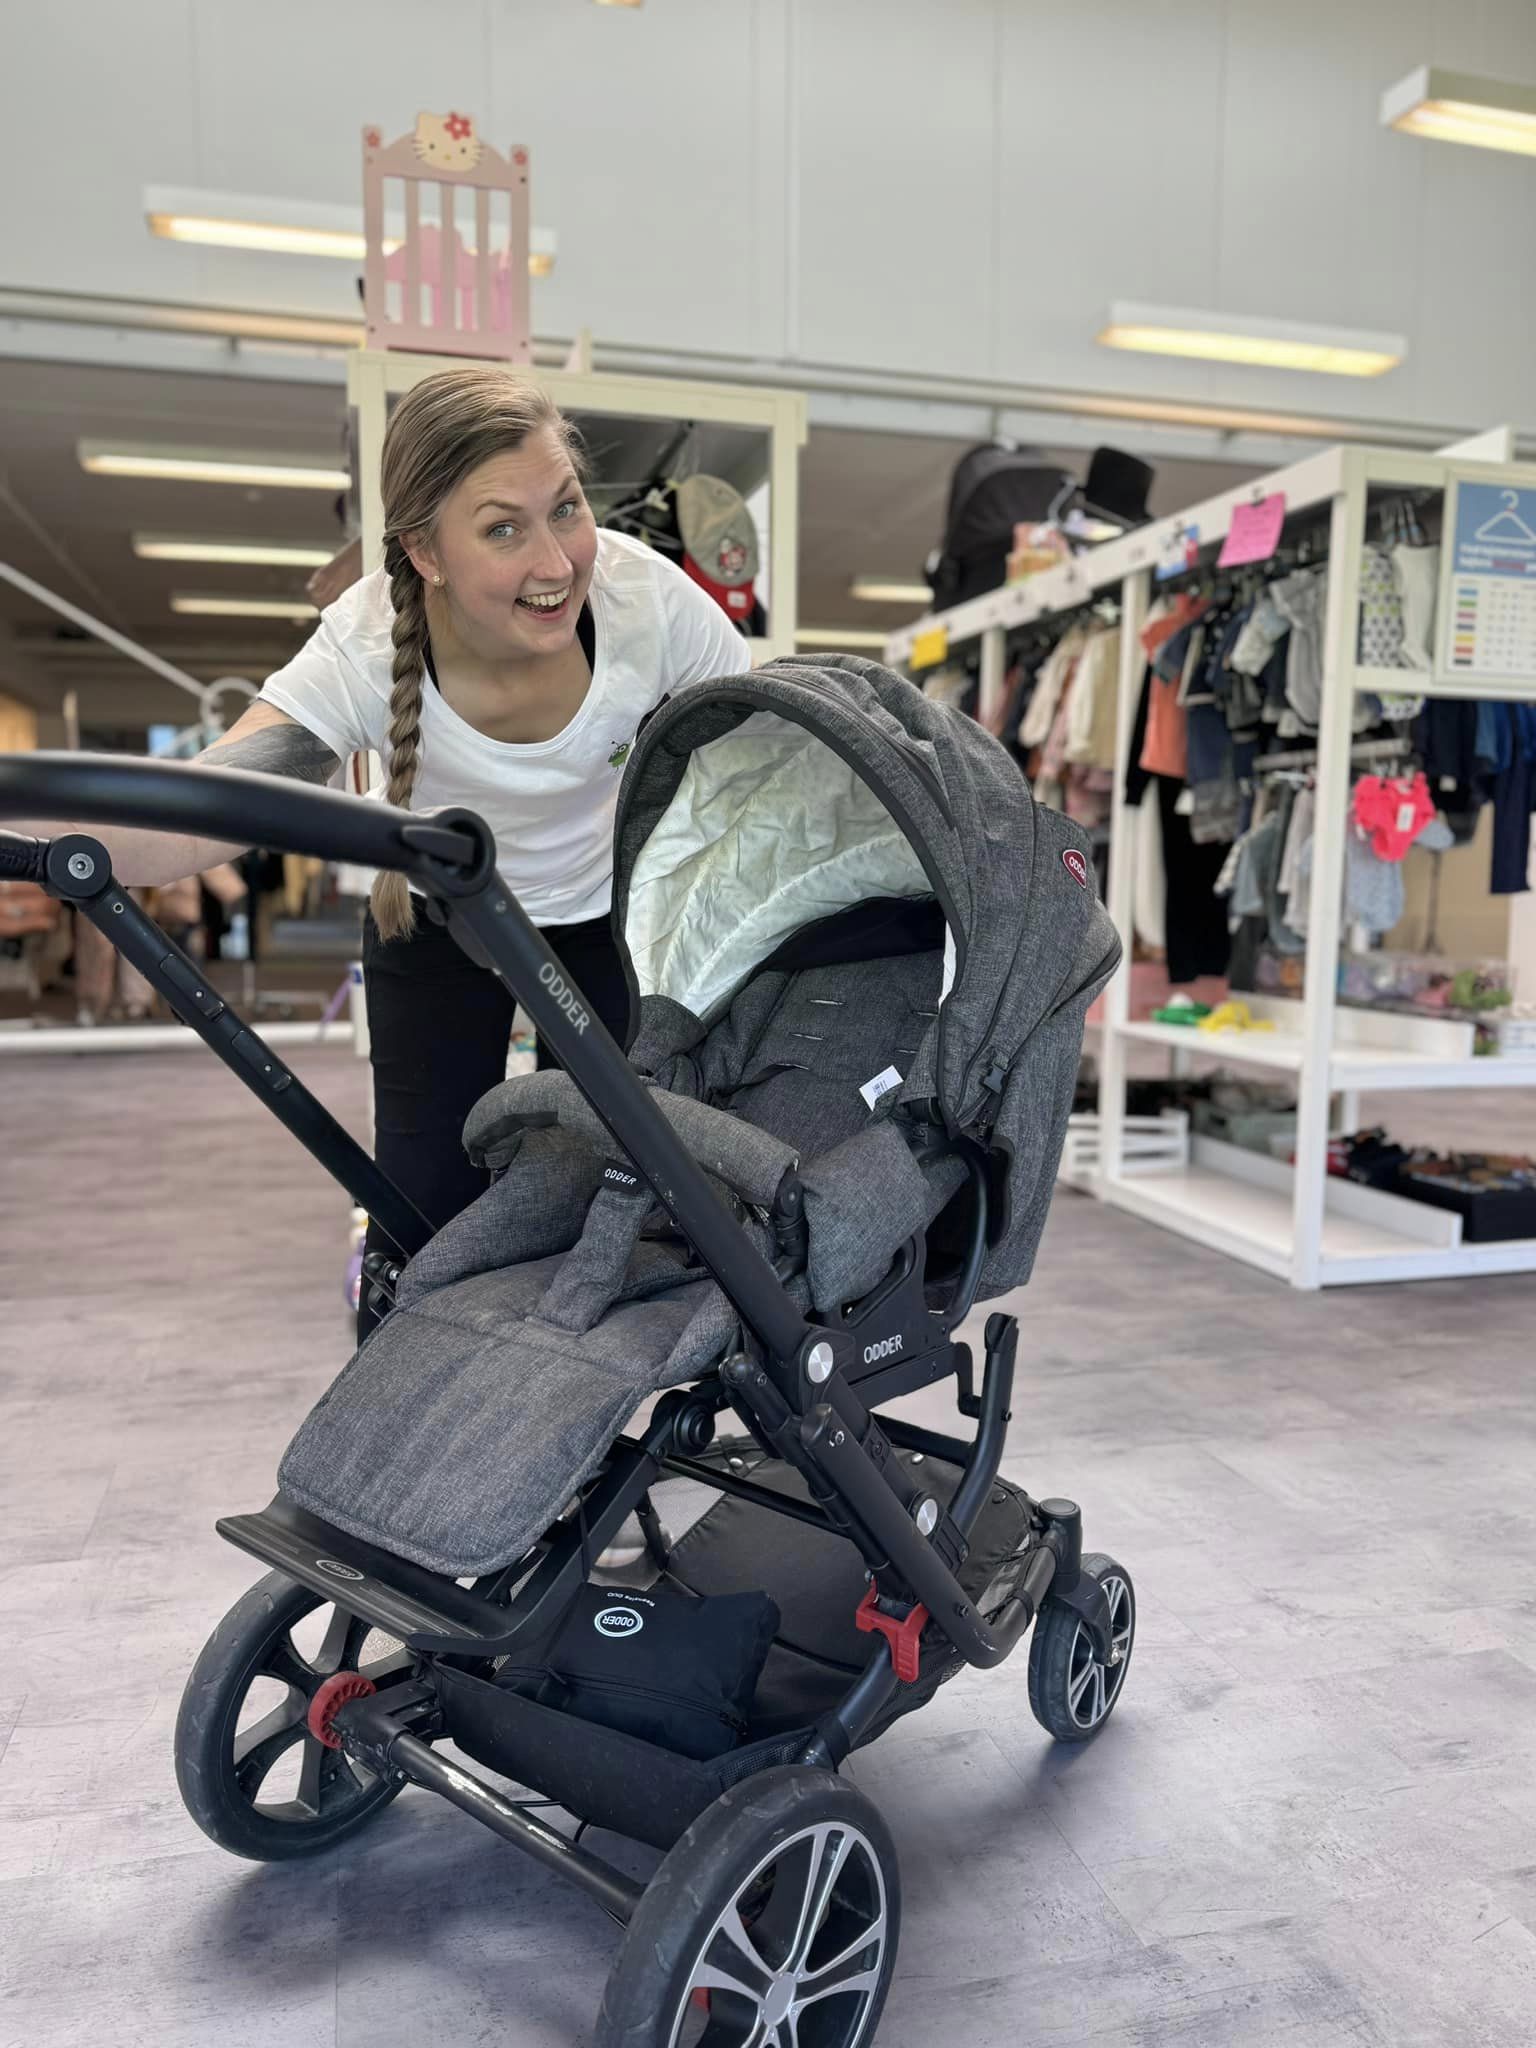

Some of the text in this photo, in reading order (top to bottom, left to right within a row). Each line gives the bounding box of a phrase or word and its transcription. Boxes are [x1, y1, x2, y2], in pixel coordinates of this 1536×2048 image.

[539, 962, 590, 1035] ODDER
[604, 1168, 637, 1185] ODDER
[863, 1334, 903, 1364] ODDER
[602, 1615, 635, 1627] ODDER
